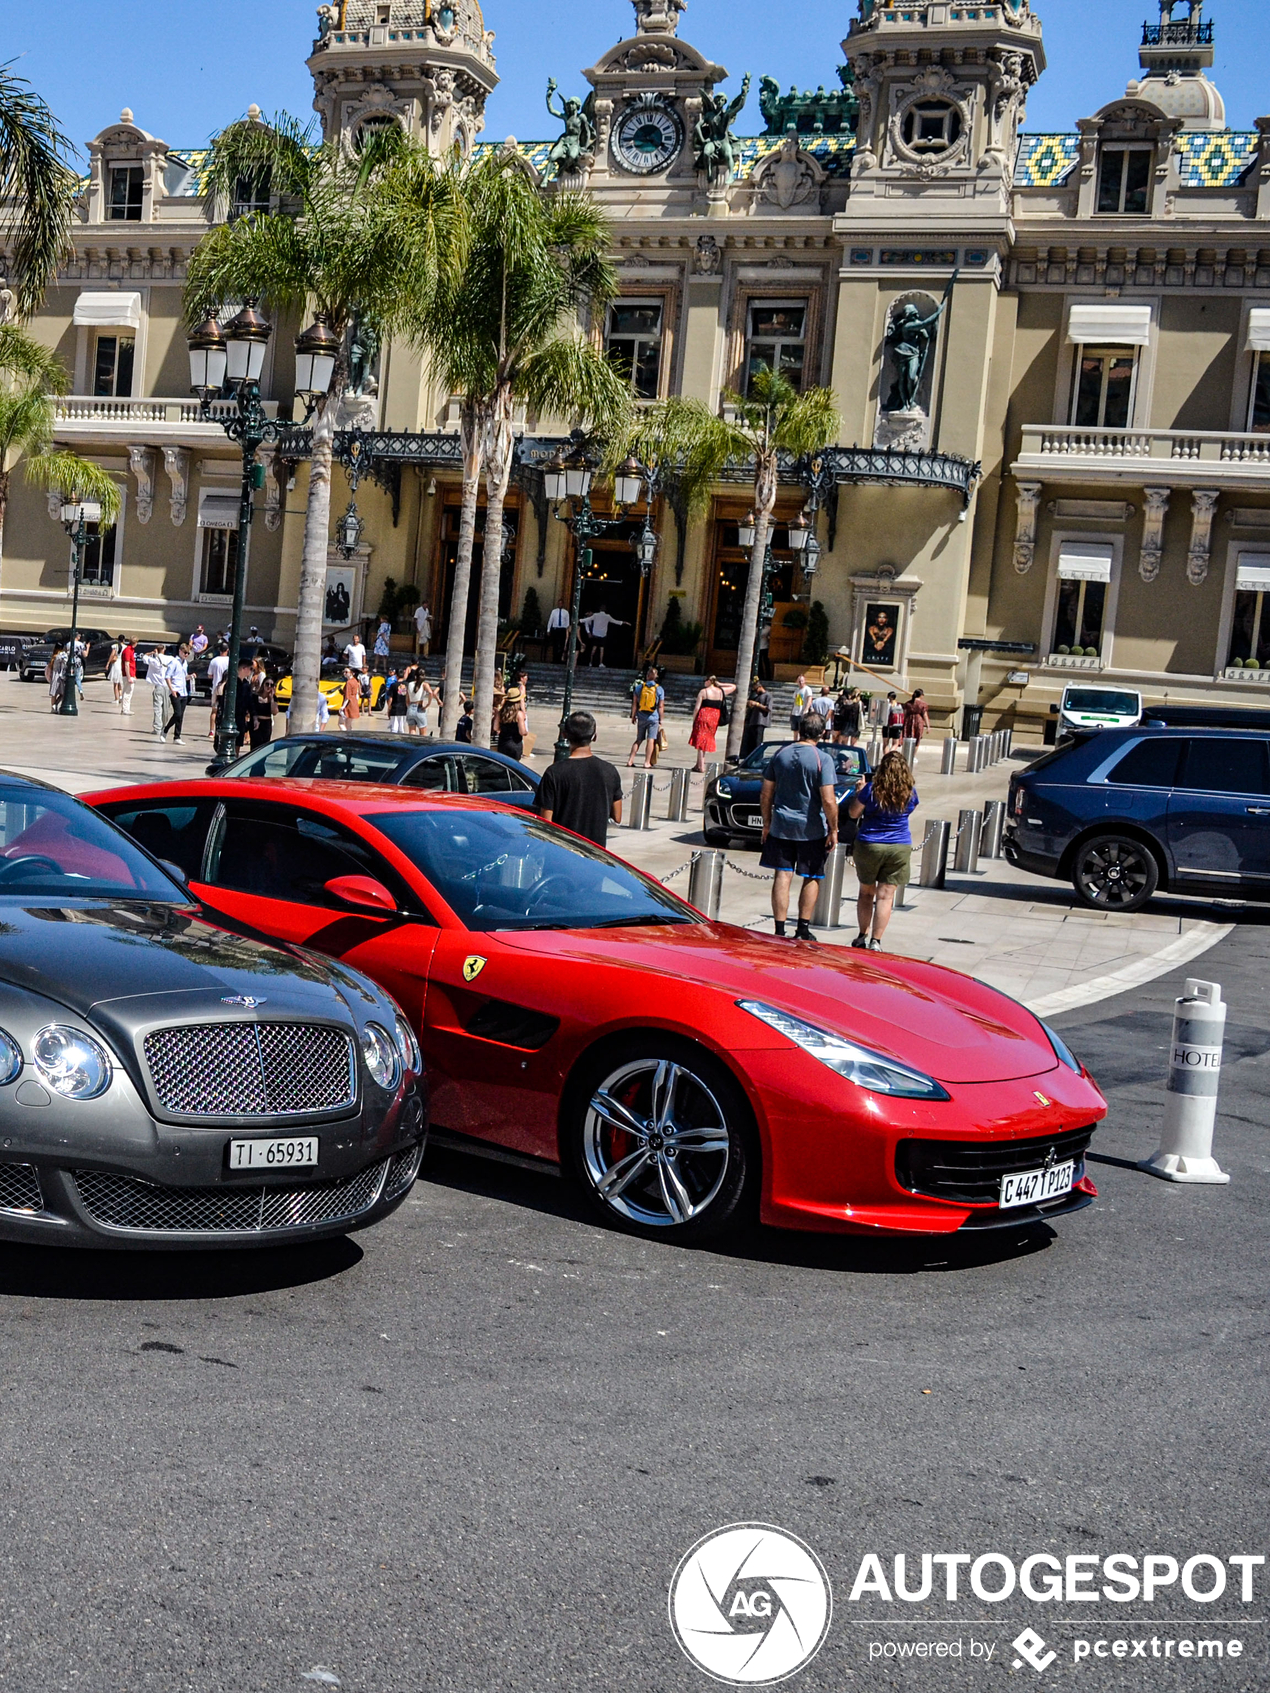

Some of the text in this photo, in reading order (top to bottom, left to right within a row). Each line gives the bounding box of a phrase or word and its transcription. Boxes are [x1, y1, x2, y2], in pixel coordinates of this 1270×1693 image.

[1060, 571, 1105, 580] GRAFF
[1240, 581, 1267, 589] GRA
[1051, 657, 1095, 667] GRAFF
[266, 1141, 313, 1164] 65931
